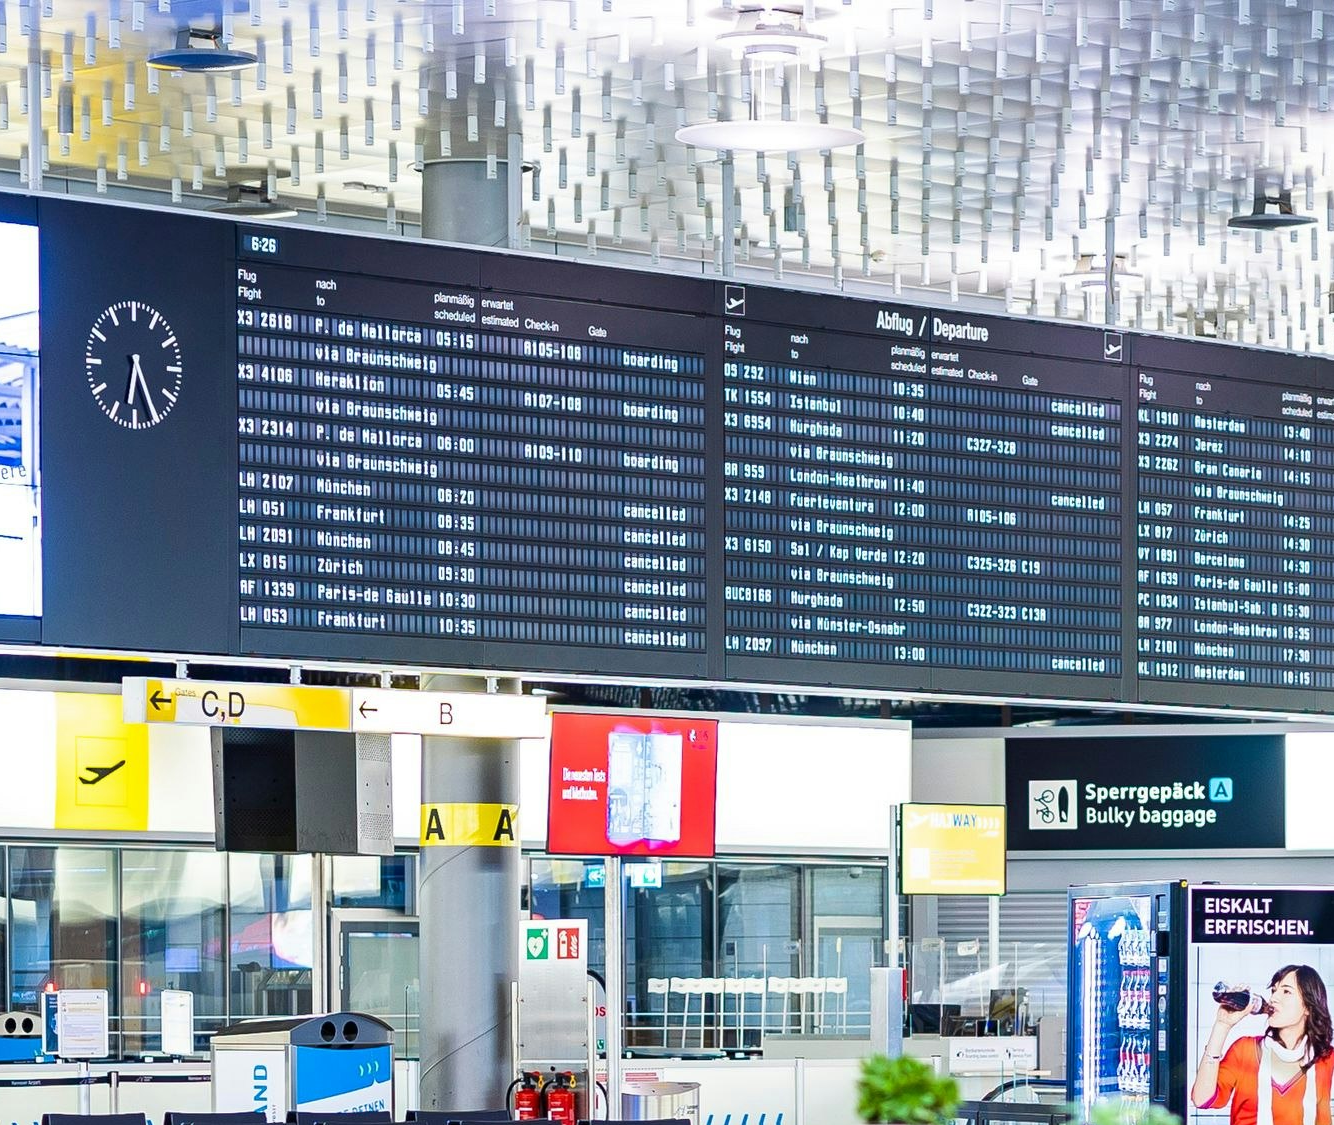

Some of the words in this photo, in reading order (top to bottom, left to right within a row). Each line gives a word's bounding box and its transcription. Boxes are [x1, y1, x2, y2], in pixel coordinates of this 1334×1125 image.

[251, 237, 275, 252] 6:26
[237, 269, 256, 283] Flug
[315, 280, 336, 290] nach
[238, 286, 261, 300] Flight
[316, 296, 325, 306] to
[237, 310, 252, 325] X3
[338, 322, 353, 336] de
[361, 324, 421, 343] Mallorca
[436, 332, 473, 348] 05:15
[623, 352, 677, 372] boarding
[524, 319, 558, 331] Check-in
[588, 326, 606, 337] Gate
[876, 311, 913, 335] Abflug
[933, 318, 988, 341] Departure
[315, 346, 338, 361] via
[238, 364, 253, 379] X3
[315, 372, 384, 391] Heraklion
[436, 384, 473, 400] 05:45
[623, 402, 678, 422] boarding
[724, 363, 737, 377] OS
[743, 366, 763, 380] 292
[789, 371, 816, 385] Wien
[893, 382, 923, 397] 10:35
[1051, 402, 1107, 417] cancelled
[724, 388, 737, 401] TK
[745, 390, 770, 405] 1554
[790, 395, 840, 412] Istanbul
[893, 406, 923, 421] 10:40
[1051, 425, 1104, 440] cancelled
[724, 413, 737, 426] X3
[744, 415, 770, 429] 6954
[790, 419, 842, 437] Hurghada
[893, 430, 924, 445] 11:20
[238, 418, 253, 433] X3
[261, 420, 293, 436] 2314
[339, 427, 354, 441] de
[362, 430, 421, 448] Mallorca
[437, 436, 473, 452] 06:00
[524, 444, 581, 462] A109-110
[623, 453, 678, 473] boarding
[239, 472, 254, 487] LH
[262, 474, 293, 489] 2107
[316, 479, 370, 496] München
[437, 488, 474, 504] 06:20
[623, 506, 685, 521] cancelled
[724, 463, 737, 475] BA
[744, 464, 764, 478] 959
[893, 479, 924, 493] 11:40
[1051, 496, 1104, 509] cancelled
[239, 499, 255, 513] LH
[262, 501, 284, 516] 051
[316, 505, 384, 523] Frankfurt
[623, 531, 685, 546] cancelled
[240, 580, 255, 594] AF
[264, 582, 294, 596] 1339
[317, 585, 378, 602] Paris-de
[386, 589, 431, 605] Gaulle
[439, 593, 475, 608] 10:30
[624, 607, 686, 621] cancelled
[439, 702, 454, 725] B
[1085, 780, 1206, 806] Sperrgepäck
[425, 808, 446, 841] A
[493, 808, 515, 841] A
[1086, 806, 1134, 829] Bulky
[1137, 807, 1217, 829] baggage
[1204, 897, 1273, 915] EISKALT
[1204, 918, 1315, 936] ERFRISCHEN.
